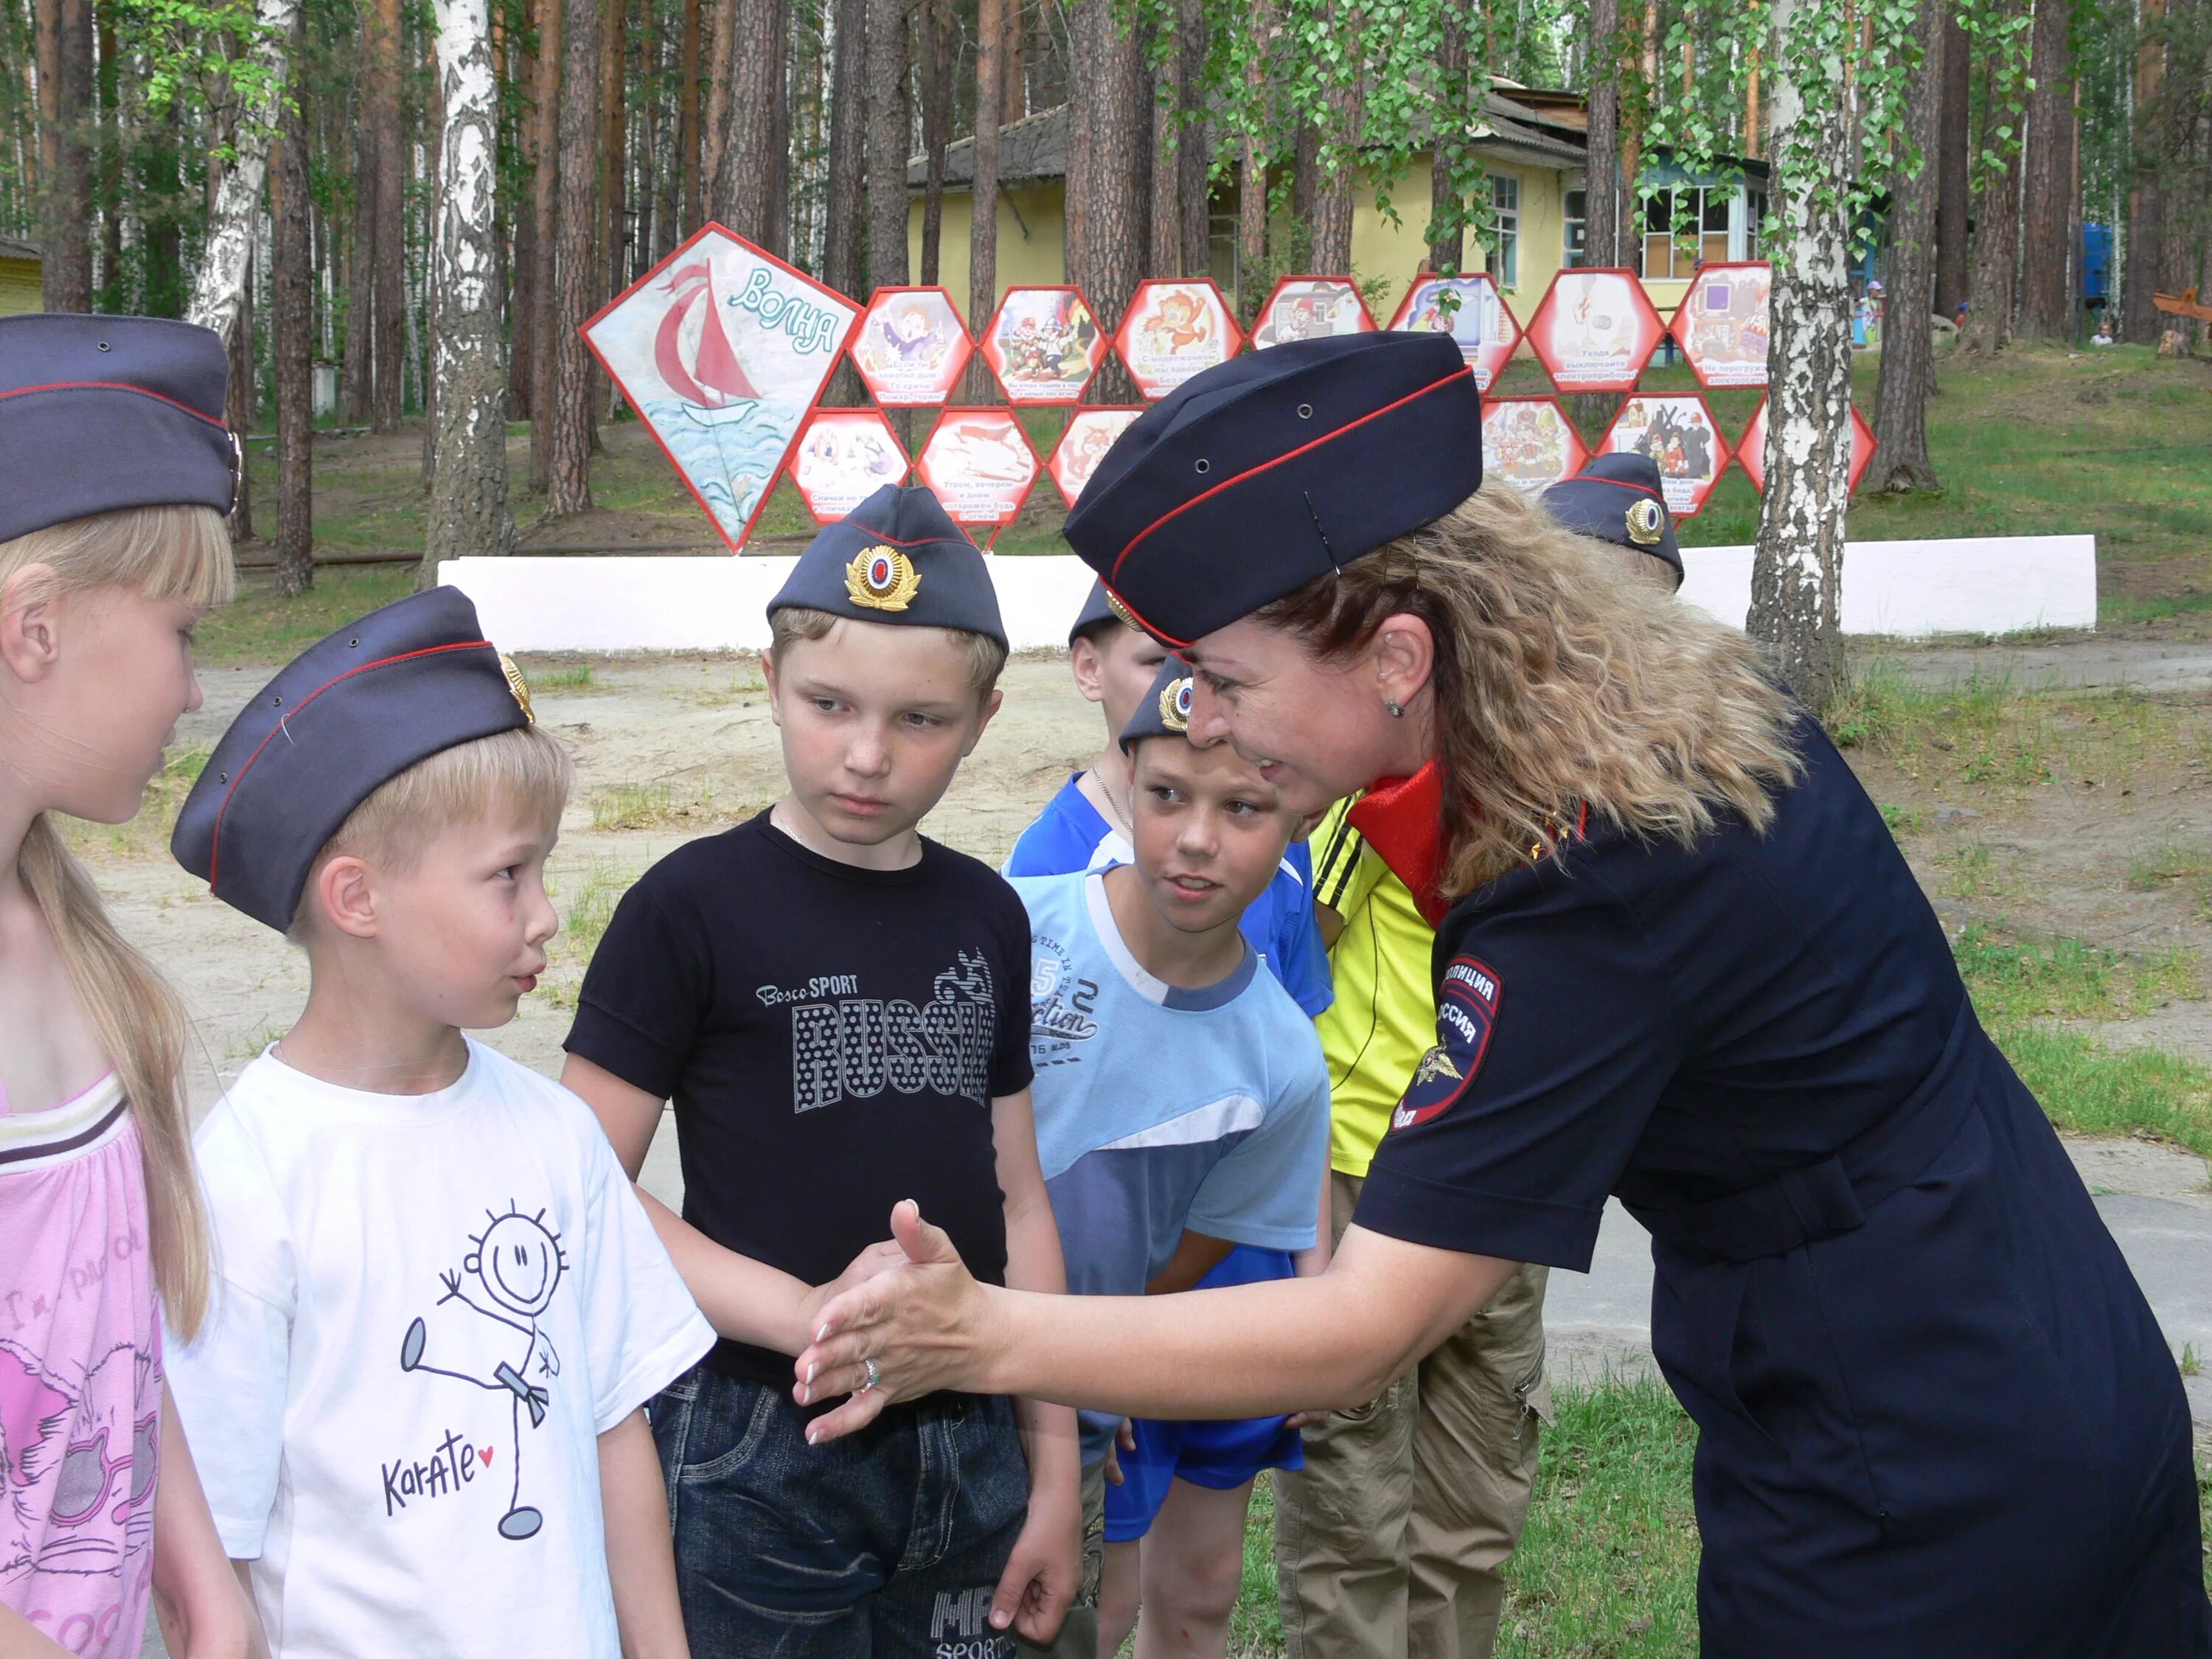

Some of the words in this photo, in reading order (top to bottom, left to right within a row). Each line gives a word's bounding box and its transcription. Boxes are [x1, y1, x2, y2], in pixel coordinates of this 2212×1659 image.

[1565, 361, 1626, 369] выключайте
[1719, 365, 1768, 373] перегружа
[756, 984, 809, 1009] Bosco
[808, 973, 859, 998] SPORT
[1442, 964, 1495, 1001] ОЛИЦИЯ
